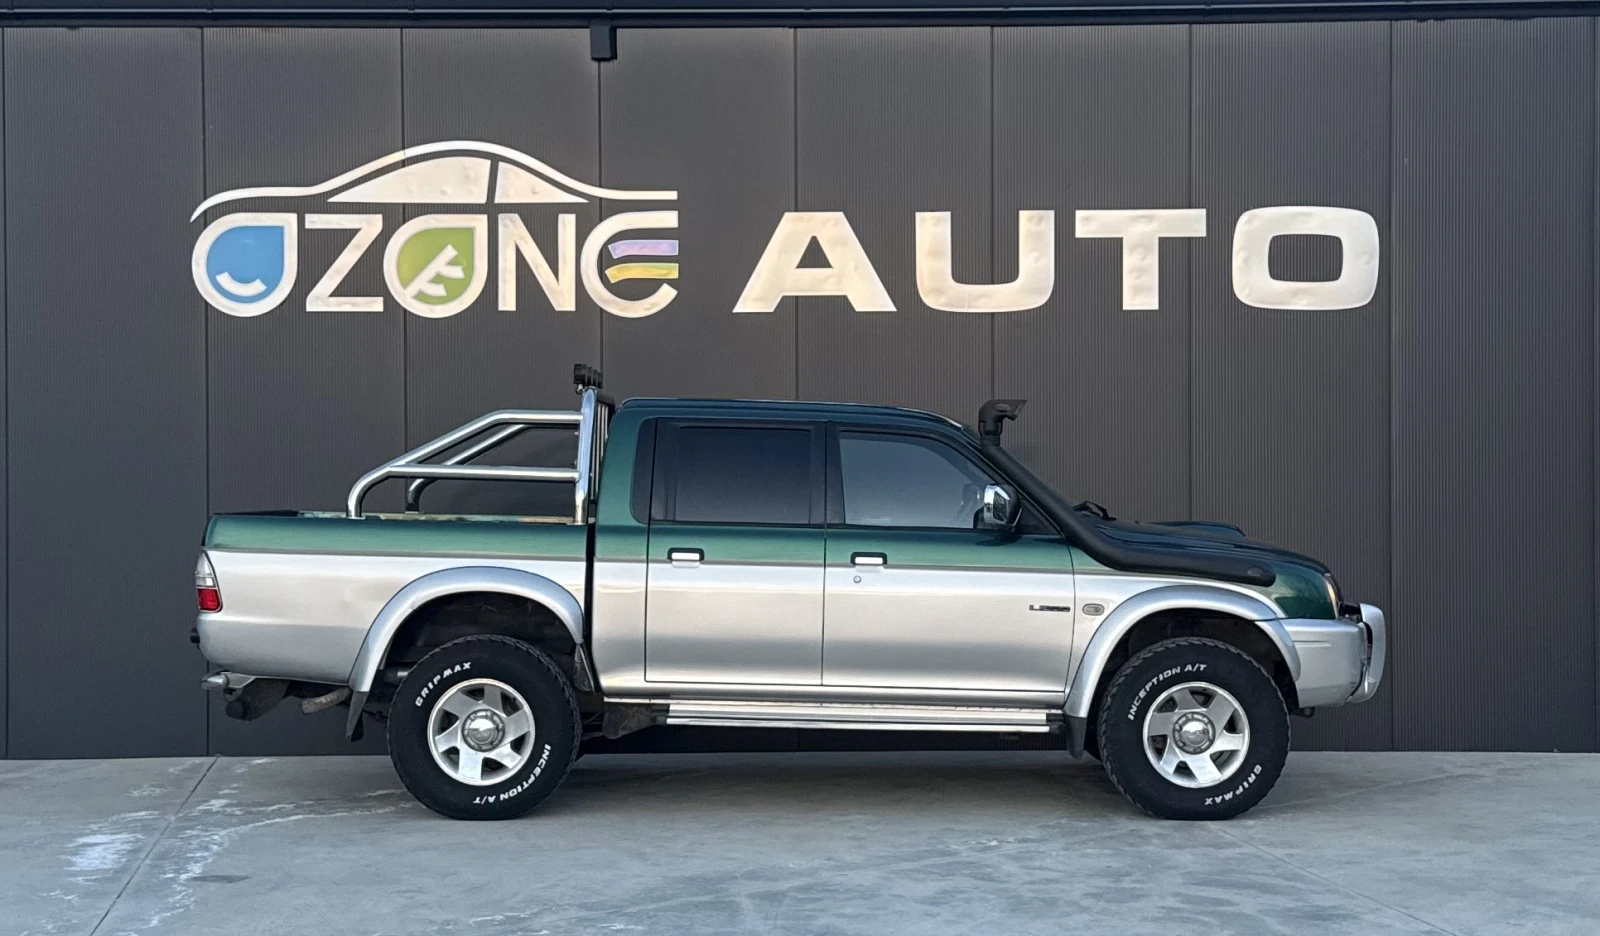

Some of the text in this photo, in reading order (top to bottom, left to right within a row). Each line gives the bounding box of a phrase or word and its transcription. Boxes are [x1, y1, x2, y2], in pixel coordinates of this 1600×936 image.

[191, 205, 1380, 318] OZONE AUTO
[415, 661, 472, 707] GRIPMAX
[1127, 663, 1208, 721] INCEPTION A/T
[472, 743, 552, 805] INCEPTION A/T
[1204, 764, 1262, 806] GRIPMAX
